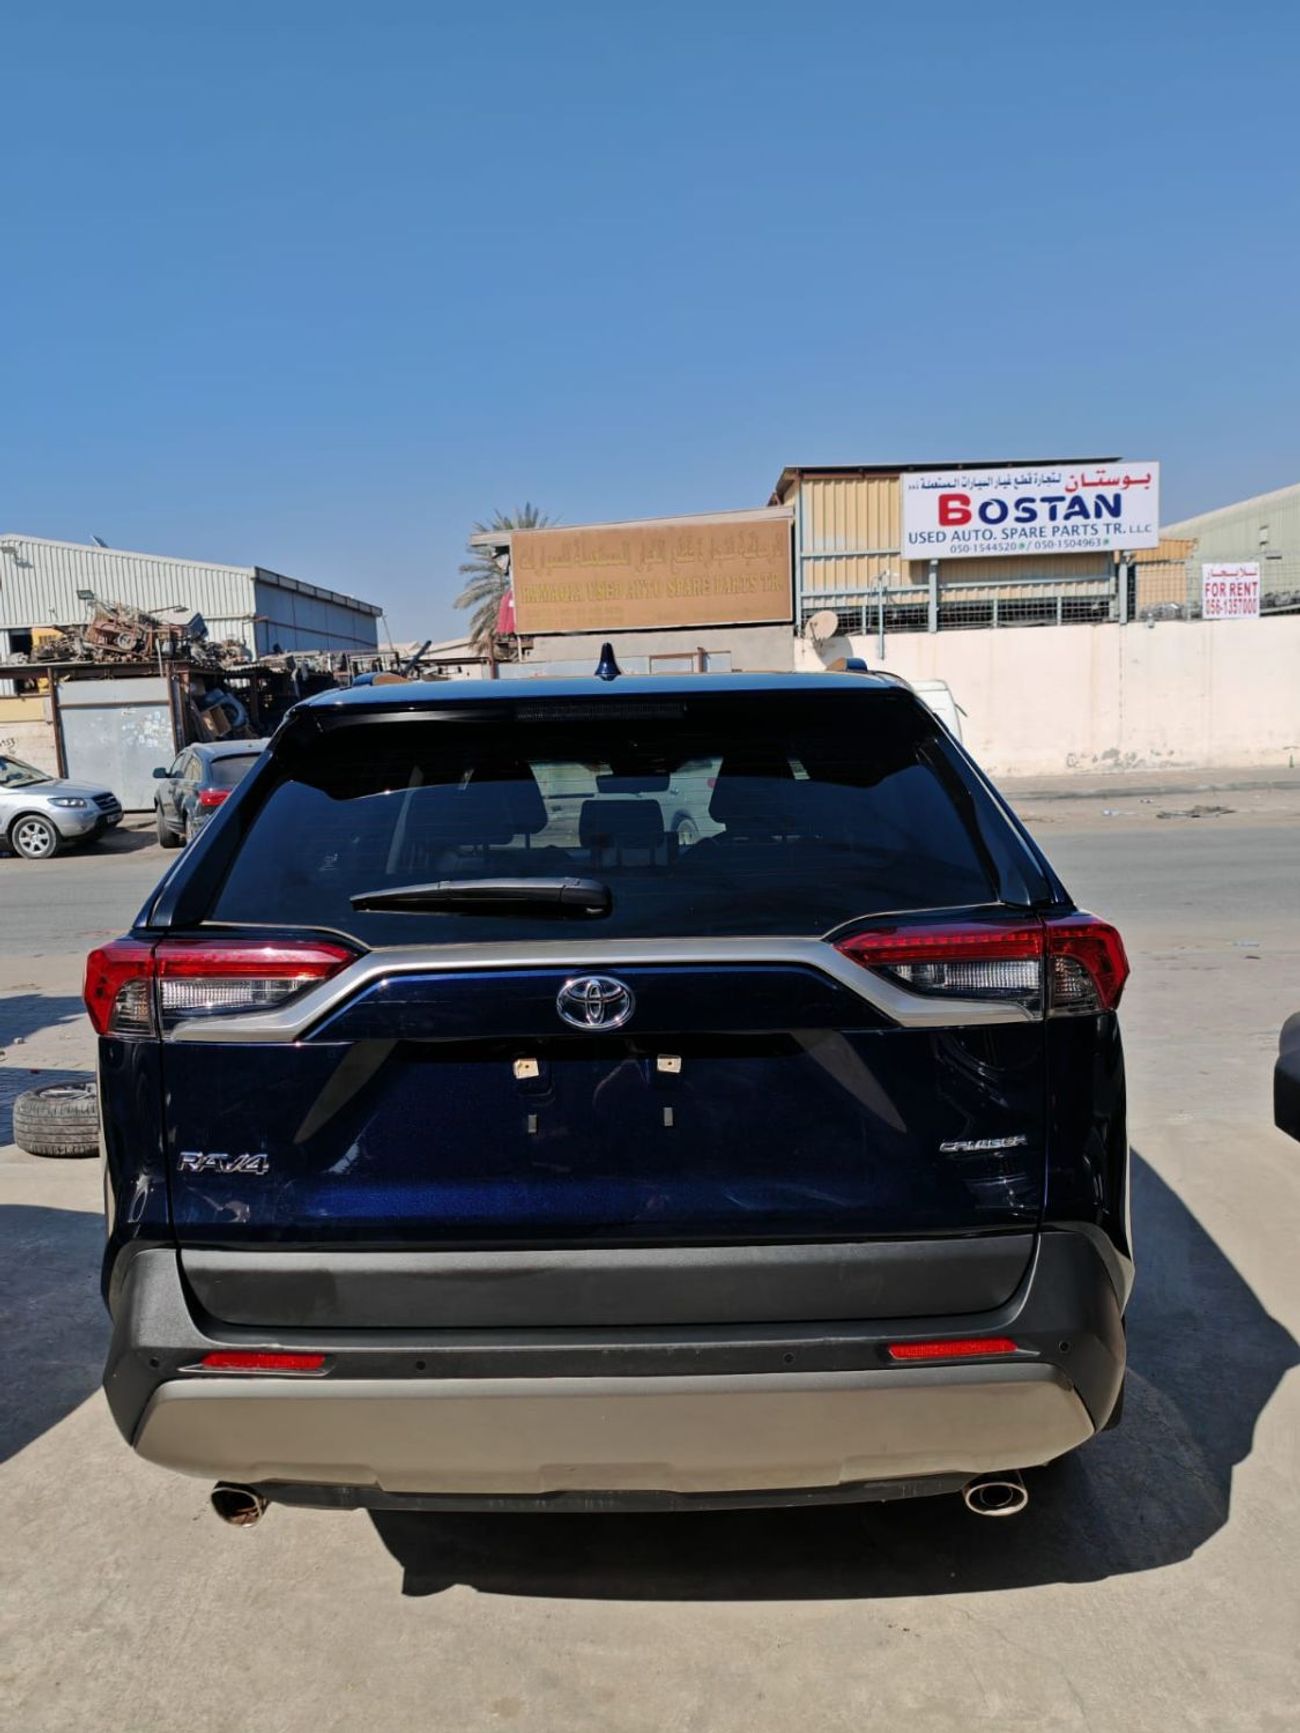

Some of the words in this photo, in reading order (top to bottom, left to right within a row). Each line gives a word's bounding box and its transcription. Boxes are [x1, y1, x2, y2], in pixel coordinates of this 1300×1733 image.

[1065, 469, 1152, 493] بوستان
[938, 493, 1122, 526] BOSTAN
[908, 531, 947, 545] USED
[1001, 525, 1047, 540] SPARE
[1052, 523, 1098, 537] PARTS
[1103, 522, 1126, 534] TR.
[950, 543, 1017, 554] 050-1544520
[1034, 538, 1102, 550] 050-1504963
[1205, 582, 1226, 597] FOR
[1230, 581, 1258, 597] RENT
[177, 1152, 269, 1175] RAV4
